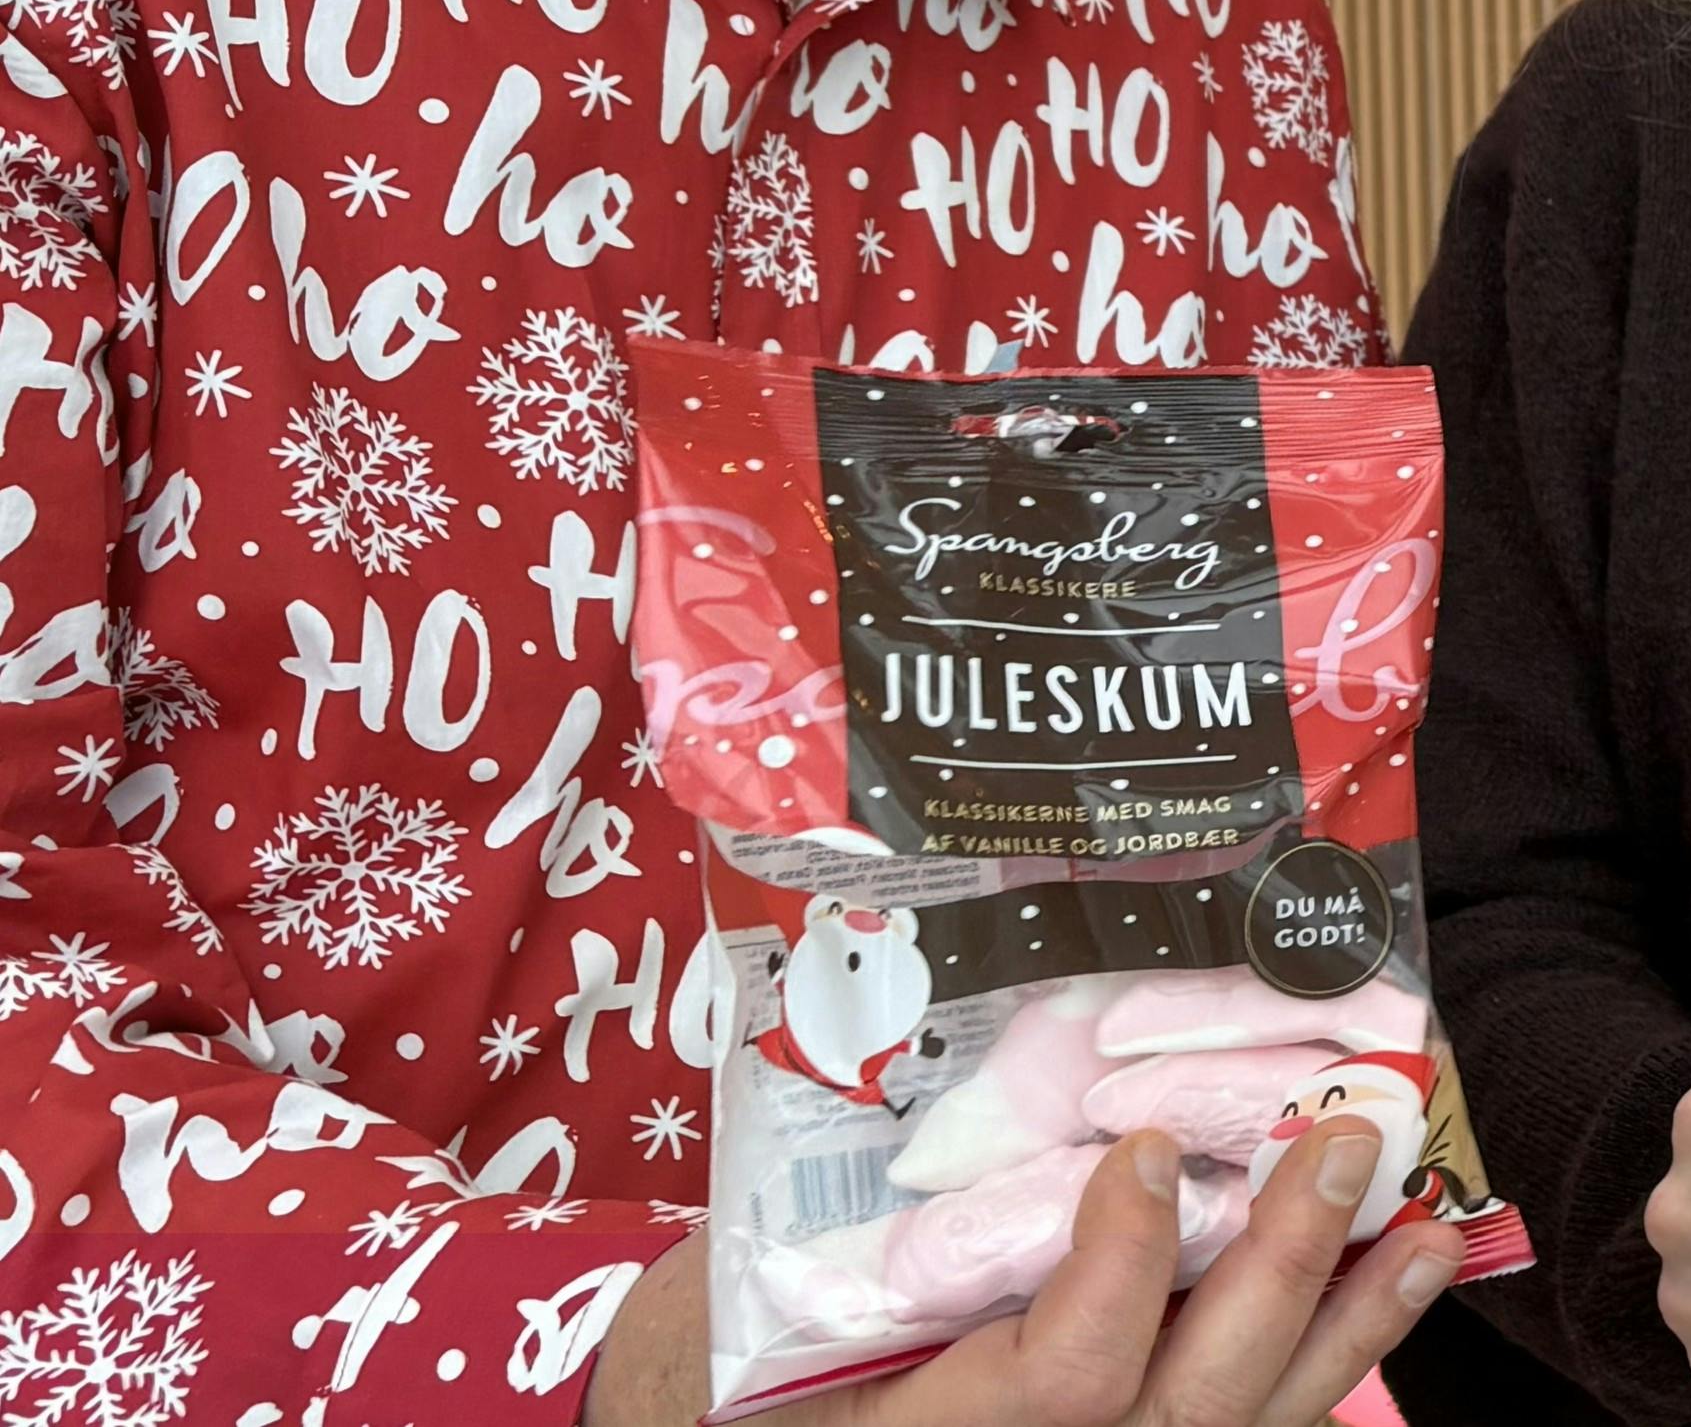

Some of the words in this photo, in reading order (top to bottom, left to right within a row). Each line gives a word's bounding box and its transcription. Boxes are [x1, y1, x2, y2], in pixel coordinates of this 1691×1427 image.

[444, 64, 634, 268] ho
[1036, 56, 1171, 187] HO
[900, 120, 1035, 268] HO
[1207, 131, 1330, 286] ho
[269, 177, 462, 381] ho
[1077, 221, 1206, 369] ho
[884, 497, 1222, 589] Spangsberg
[978, 570, 1138, 600] KLASSIKERE
[280, 588, 491, 760] HO
[880, 652, 1252, 733] JULESKUM
[920, 833, 956, 853] AF
[959, 834, 1065, 855] VANILLE
[1069, 837, 1108, 856] OG
[1113, 828, 1241, 855] JORDBÆR
[924, 799, 1090, 823] KLASSIKERNE
[1096, 801, 1153, 823] MED
[1160, 796, 1232, 817] SMAG
[1273, 923, 1367, 950] GODT!
[1275, 896, 1317, 920] DU
[1323, 886, 1366, 916] MÅ
